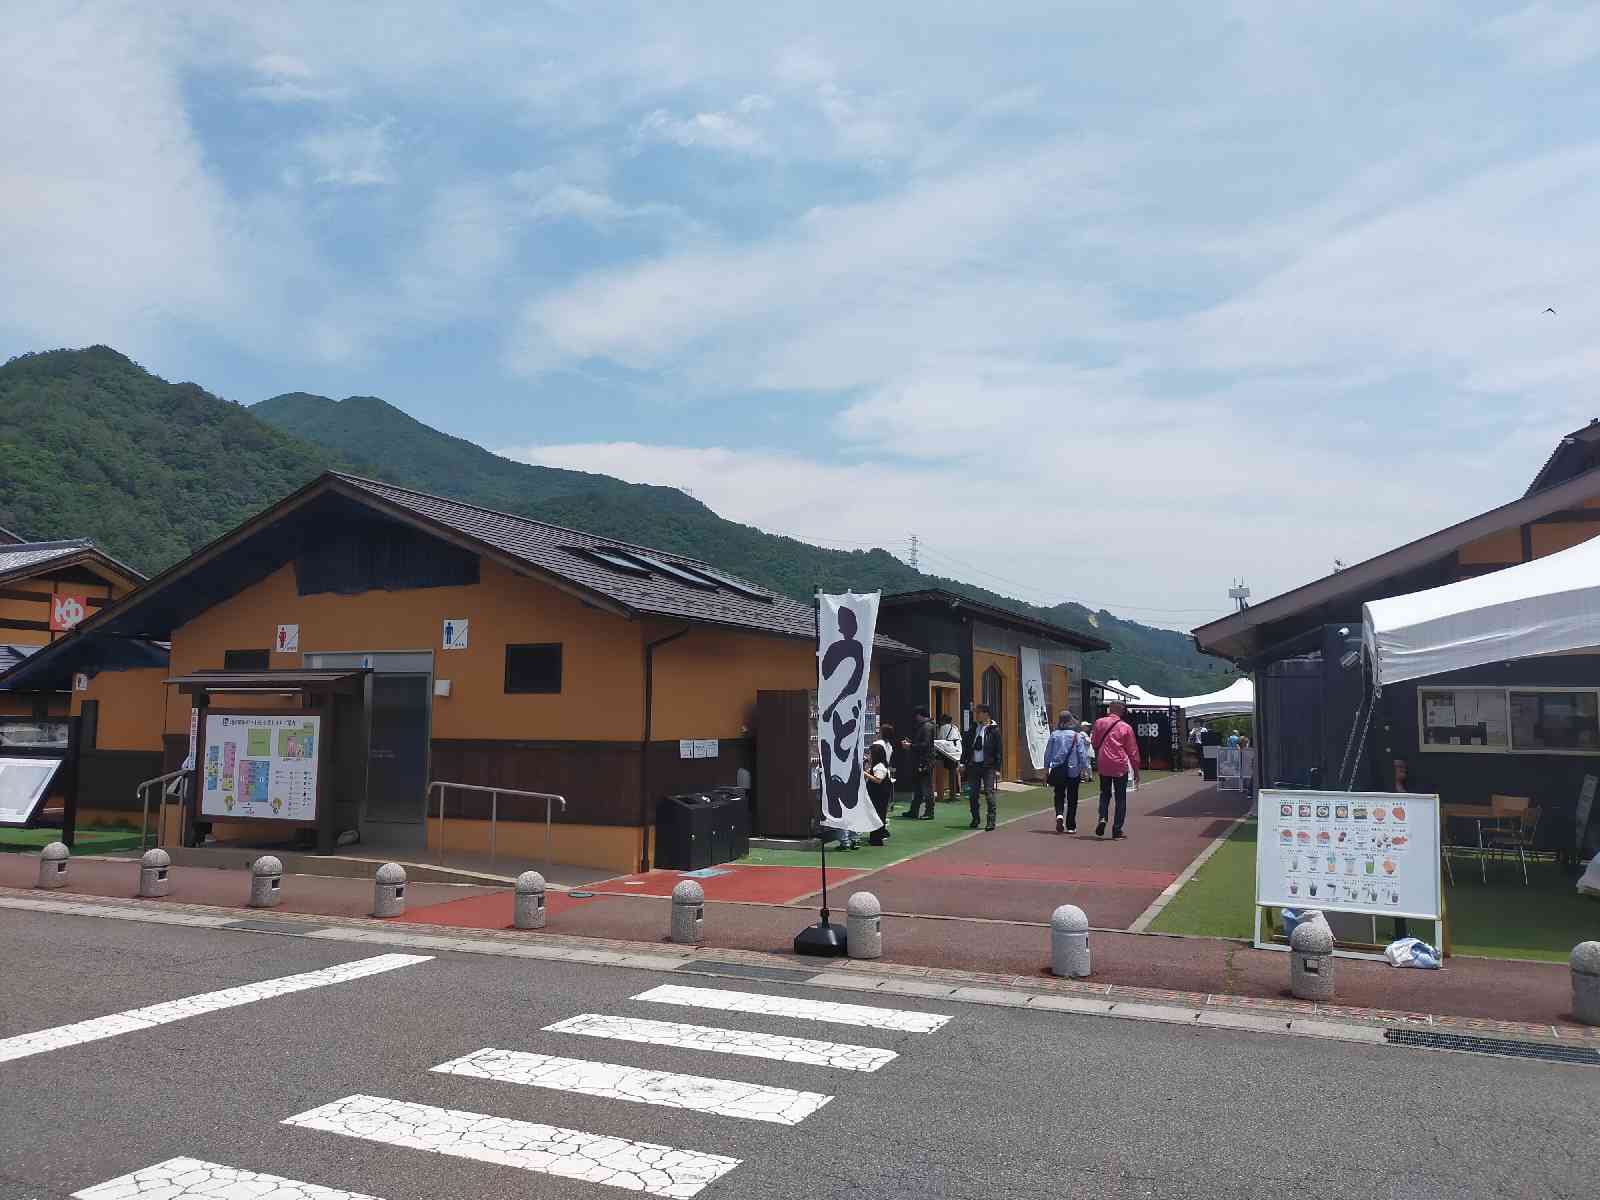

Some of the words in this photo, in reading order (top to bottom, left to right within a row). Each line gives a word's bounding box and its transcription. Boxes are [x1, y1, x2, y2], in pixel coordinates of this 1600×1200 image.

[55, 598, 84, 630] ゆ
[822, 606, 864, 819] うどん
